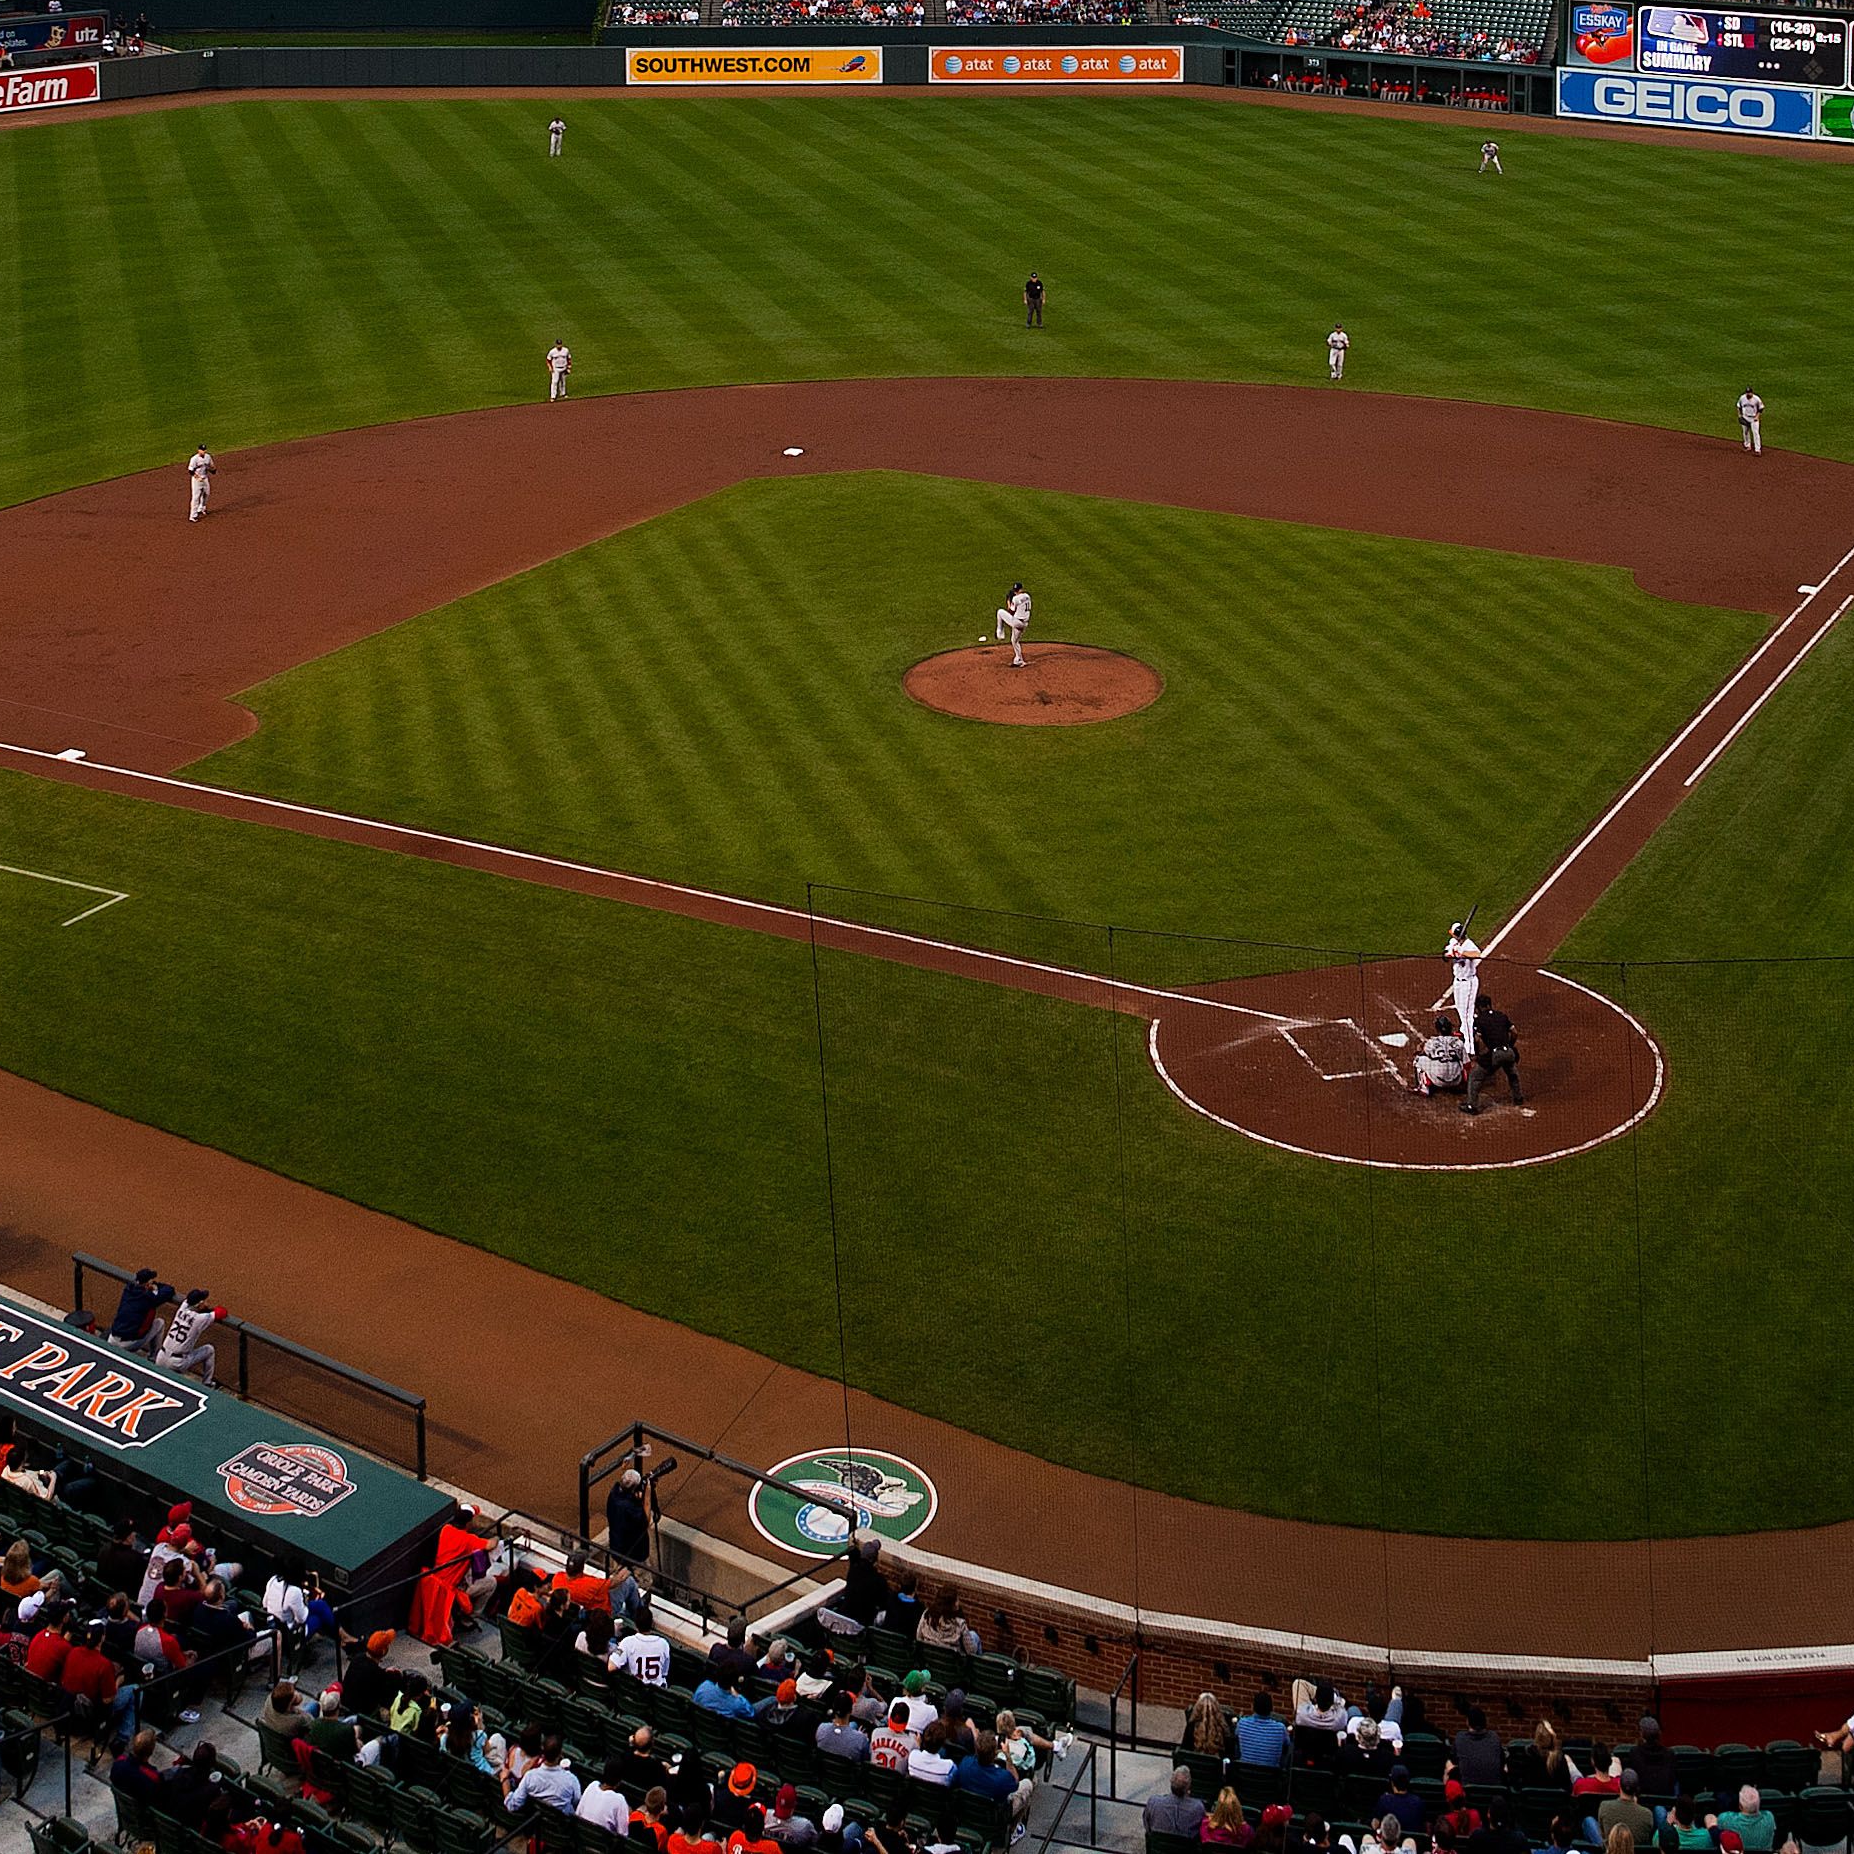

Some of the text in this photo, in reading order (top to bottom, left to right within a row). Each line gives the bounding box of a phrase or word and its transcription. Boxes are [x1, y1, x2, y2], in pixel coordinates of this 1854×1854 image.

[1579, 13, 1623, 29] ESSKAY
[1723, 17, 1816, 35] SD (16-26)
[75, 28, 99, 43] utz
[1723, 32, 1842, 54] STL (22-19) 8:15
[1656, 40, 1698, 55] IN GAME
[635, 57, 811, 75] SOUTHWEST.COM
[964, 57, 994, 72] at&t
[1023, 57, 1052, 72] at&t
[1080, 57, 1110, 72] at&t
[1138, 57, 1168, 72] at&t
[1642, 51, 1712, 72] SUMMARY
[1593, 78, 1776, 129] GEICO
[256, 1450, 306, 1477] ORIOLE
[301, 1472, 343, 1494] PARK
[228, 1461, 287, 1491] CAMDEN
[281, 1485, 326, 1510] YARDS
[635, 1656, 661, 1679] 15
